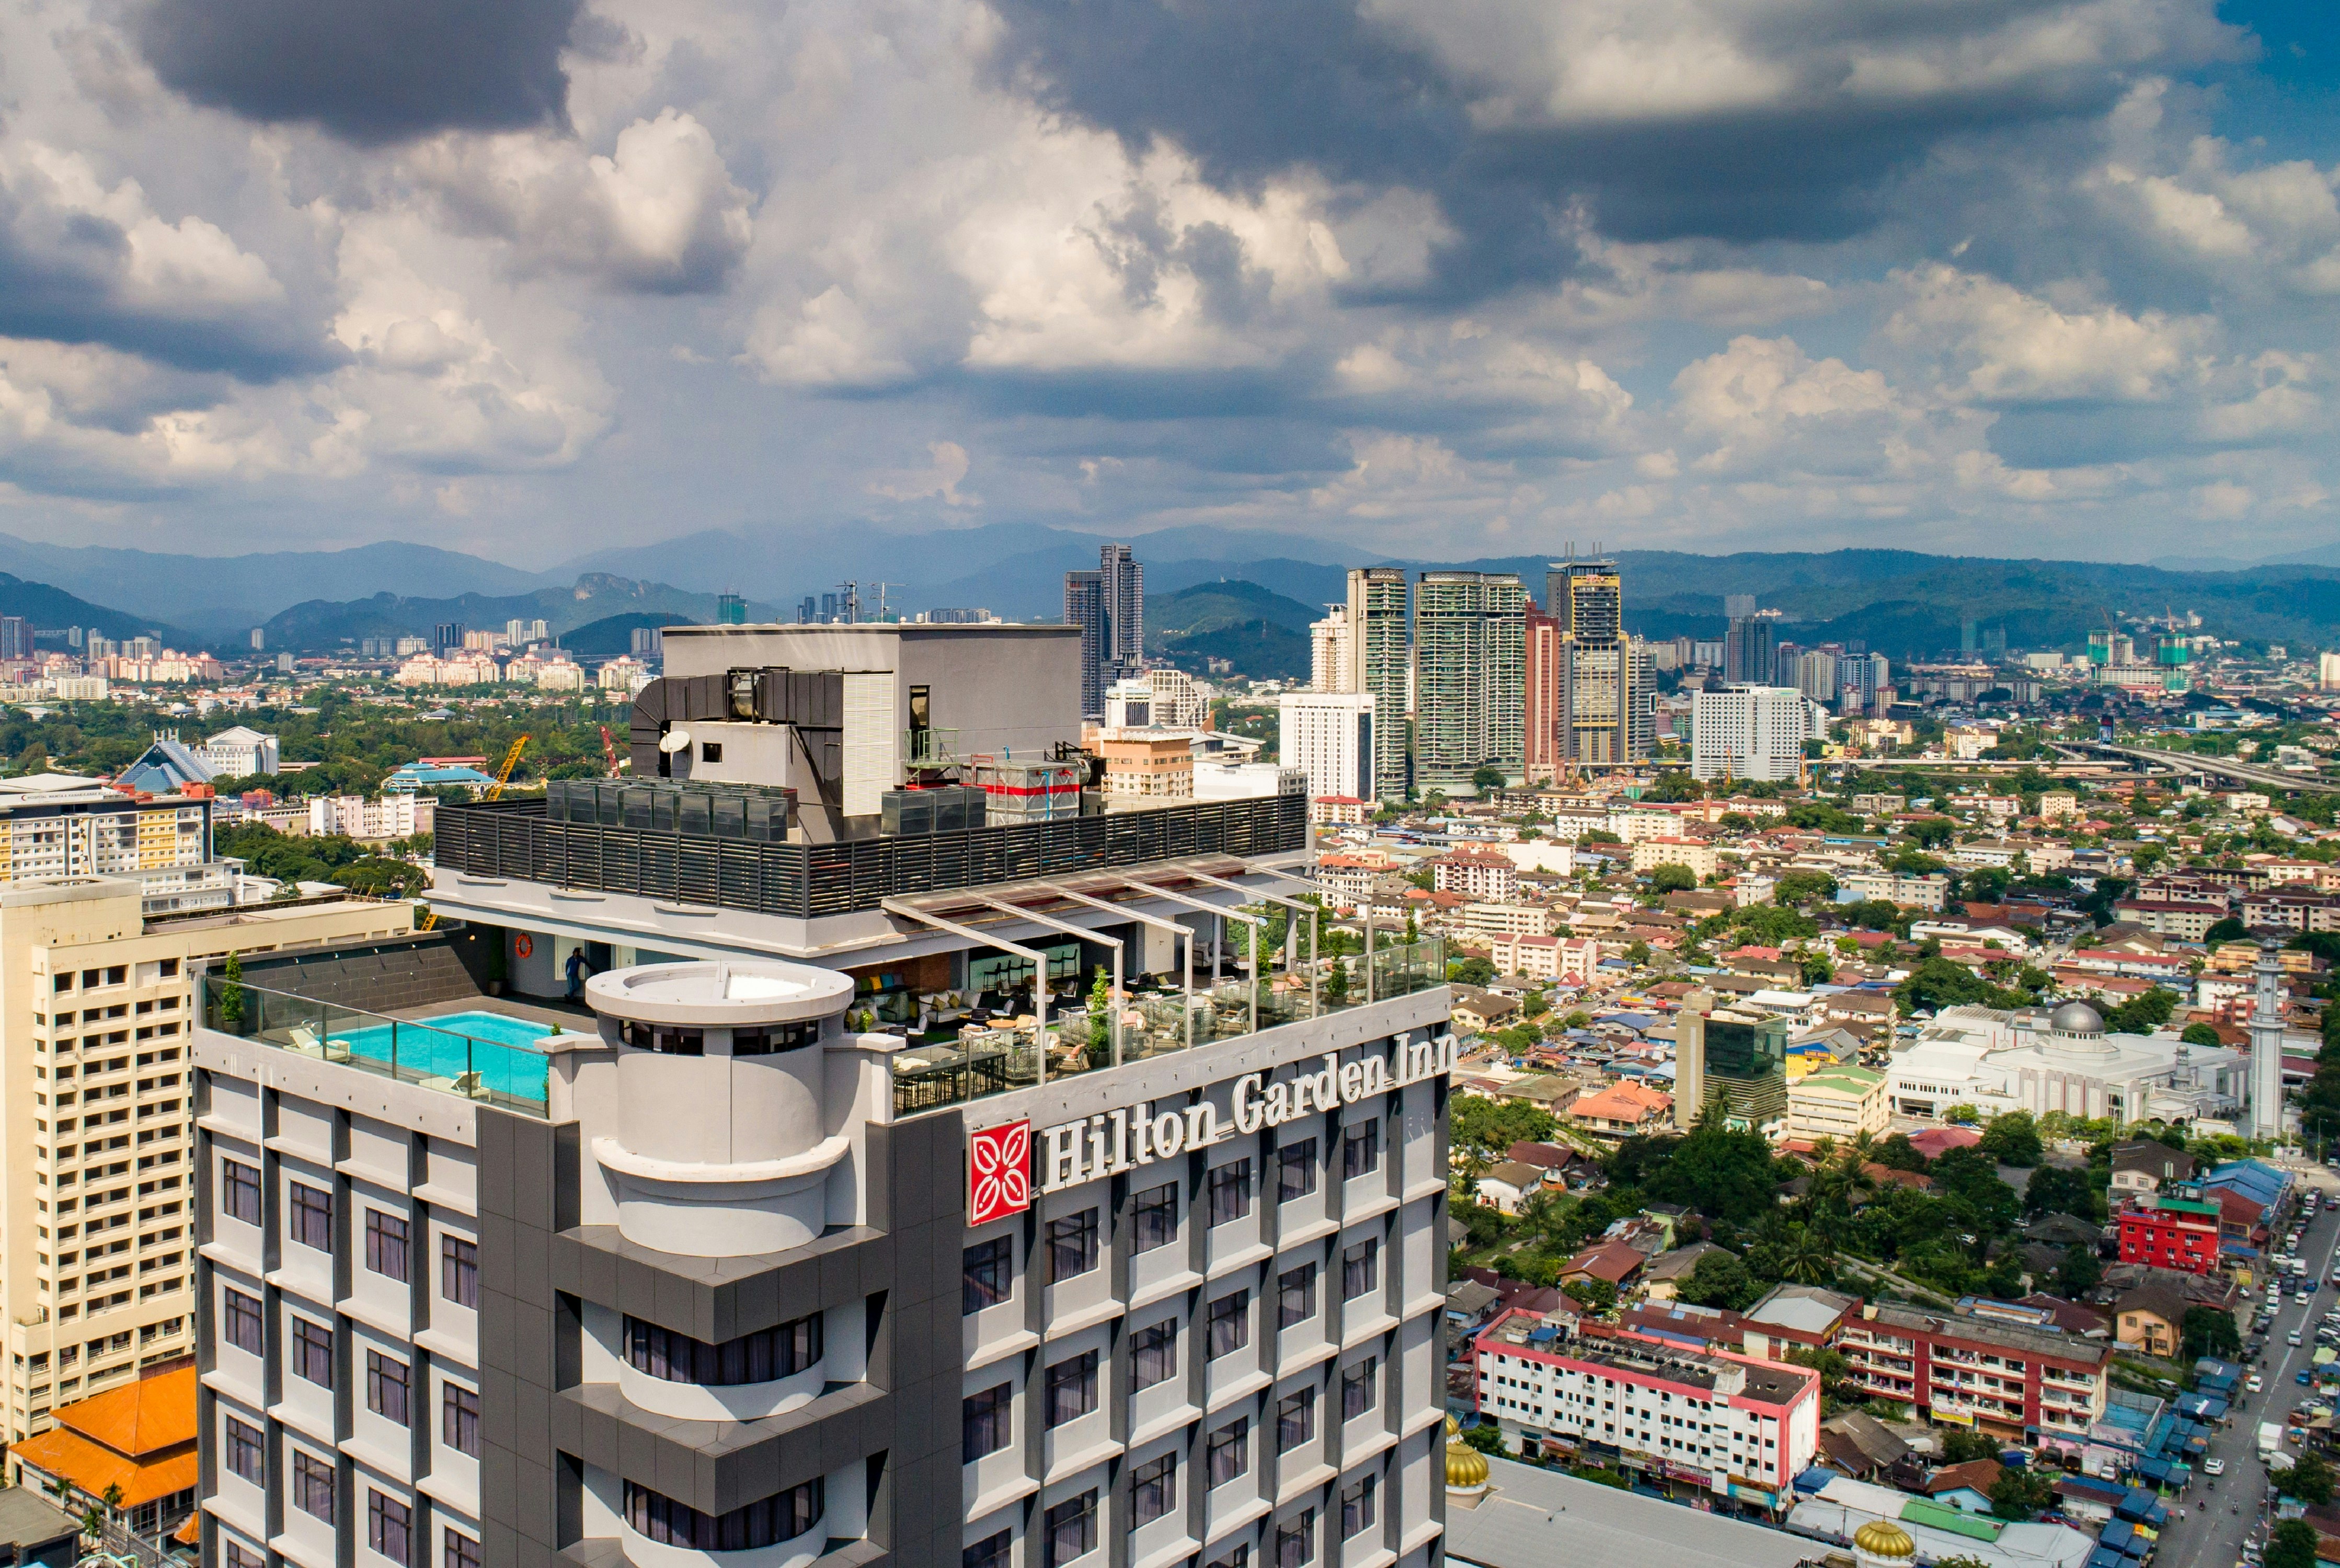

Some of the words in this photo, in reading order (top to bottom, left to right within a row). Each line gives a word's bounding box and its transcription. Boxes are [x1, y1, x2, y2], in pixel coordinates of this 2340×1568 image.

[1042, 1101, 1220, 1193] Hilton
[1232, 1053, 1386, 1134] Garden
[1393, 1032, 1459, 1087] Inn
